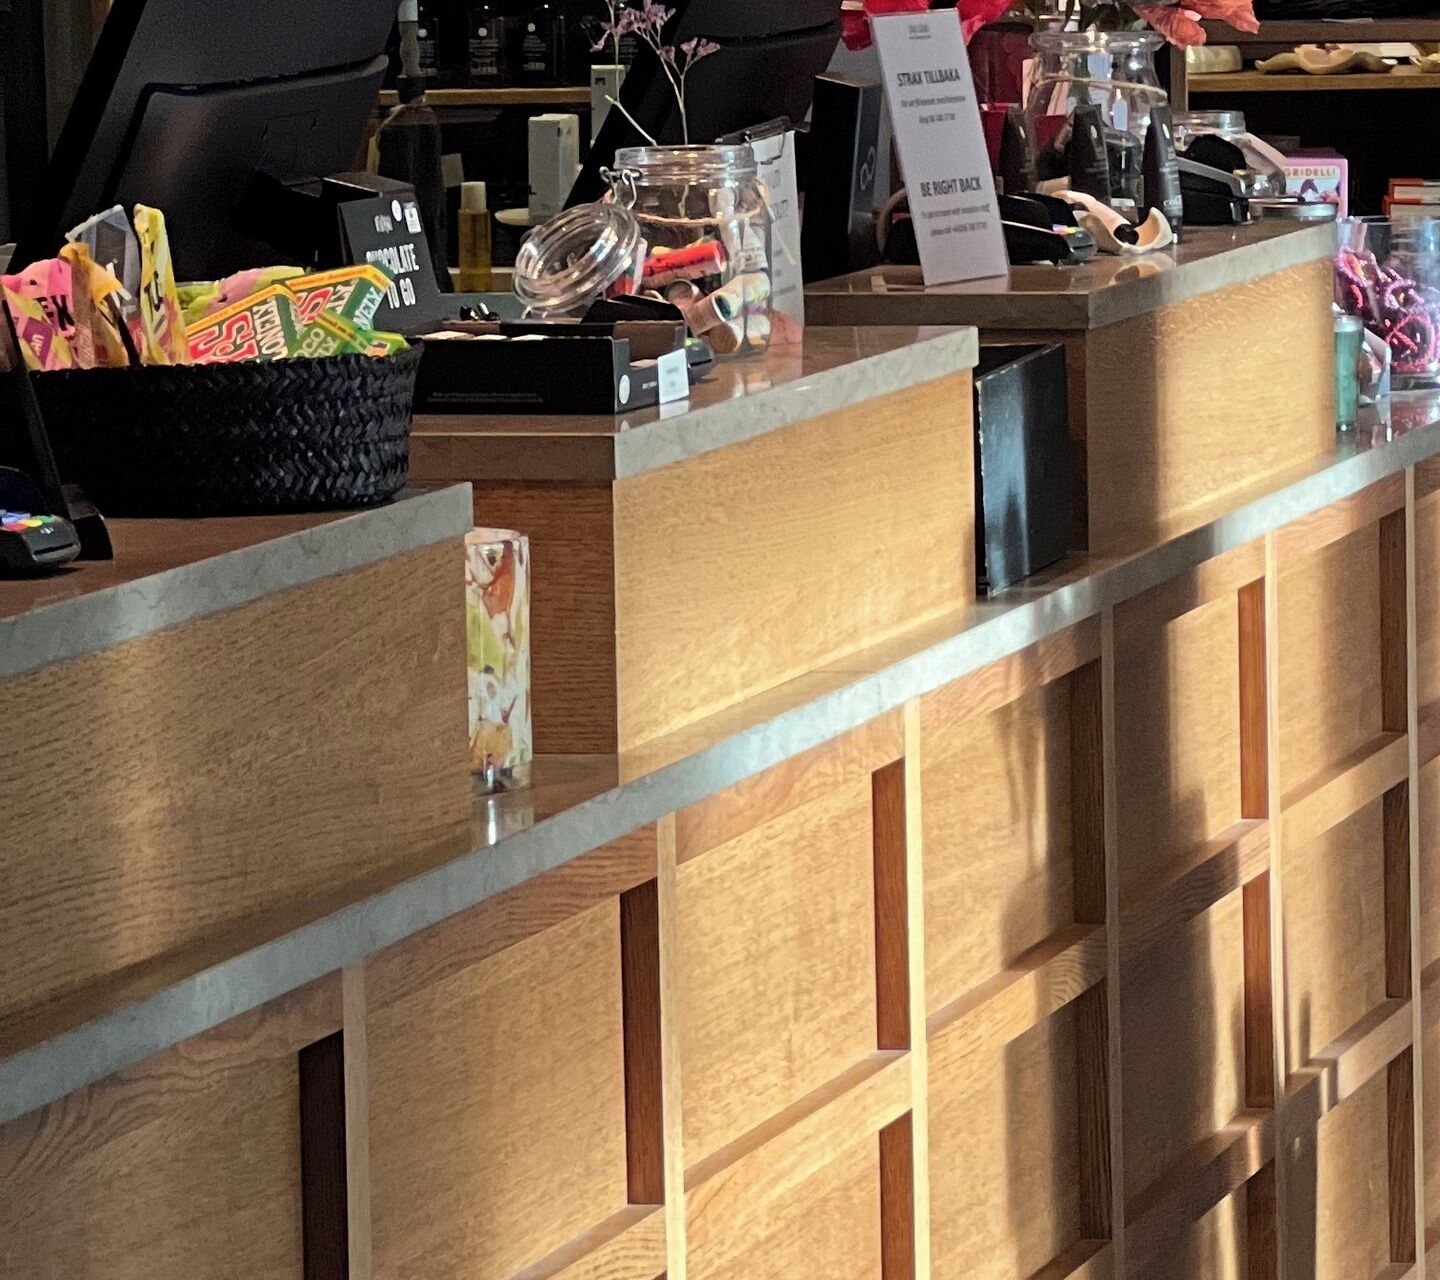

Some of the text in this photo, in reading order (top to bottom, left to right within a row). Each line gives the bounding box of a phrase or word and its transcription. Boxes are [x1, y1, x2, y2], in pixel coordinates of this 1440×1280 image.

[897, 68, 961, 87] STRAX TILLBAKA
[920, 176, 982, 197] BE RIGHT BACK
